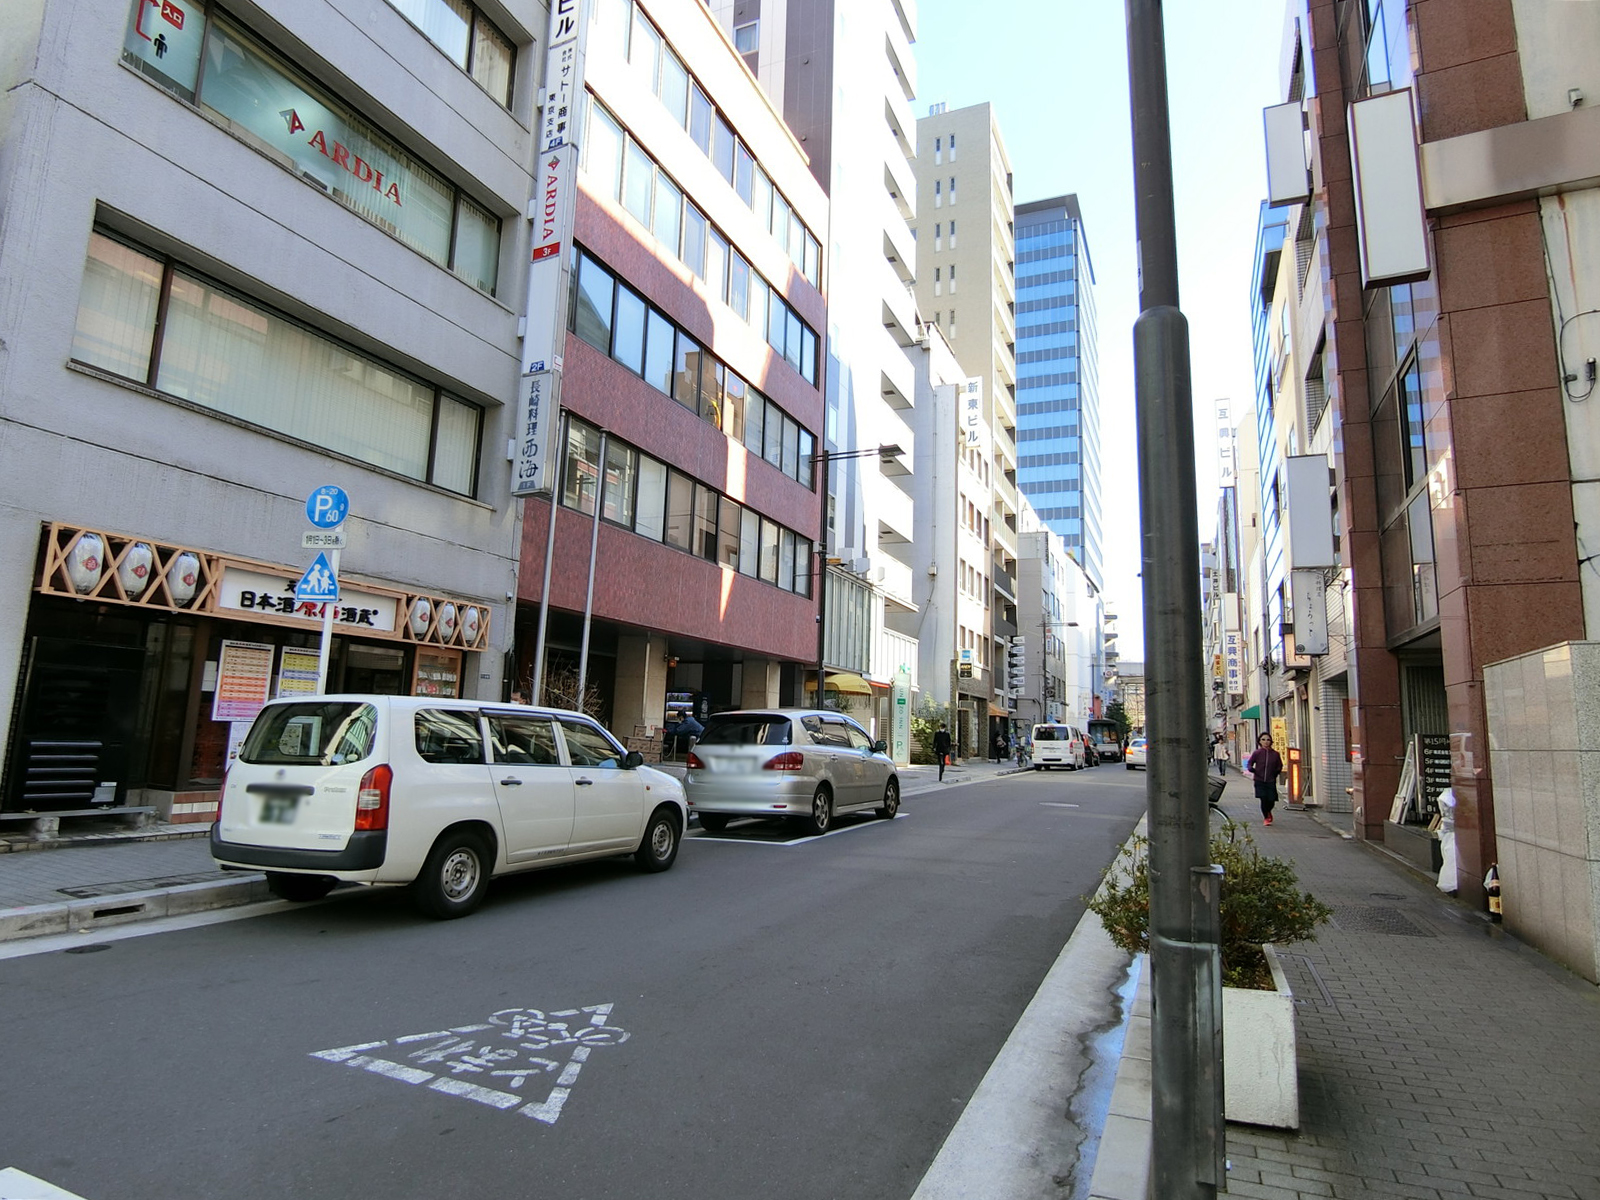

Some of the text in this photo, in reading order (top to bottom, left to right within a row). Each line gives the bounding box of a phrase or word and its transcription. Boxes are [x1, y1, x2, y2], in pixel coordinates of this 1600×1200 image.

[163, 6, 182, 24] 入口
[557, 65, 571, 134] サトー商事
[550, 137, 562, 148] 4F
[308, 130, 402, 207] ARDIA
[542, 175, 558, 241] ARDIA
[542, 246, 552, 256] 3F
[531, 361, 543, 372] 2F
[314, 494, 333, 522] P
